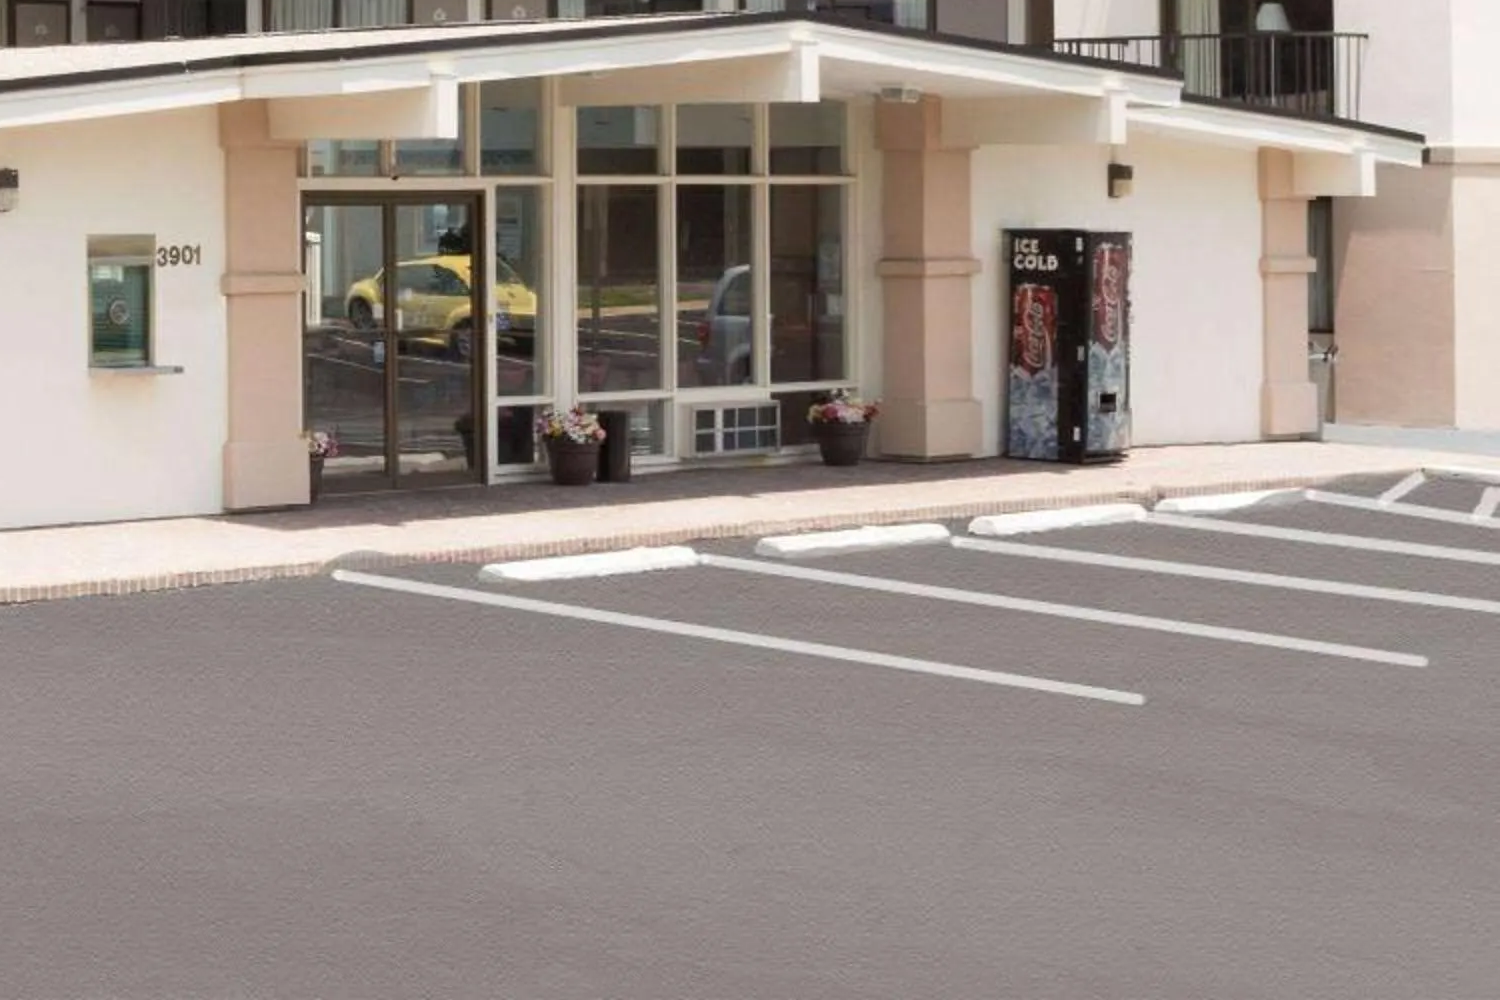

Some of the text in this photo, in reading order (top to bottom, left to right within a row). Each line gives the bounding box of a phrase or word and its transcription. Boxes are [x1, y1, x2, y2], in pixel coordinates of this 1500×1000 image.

[1014, 238, 1040, 254] ICE
[157, 244, 202, 267] 3901
[1013, 255, 1059, 271] COLD
